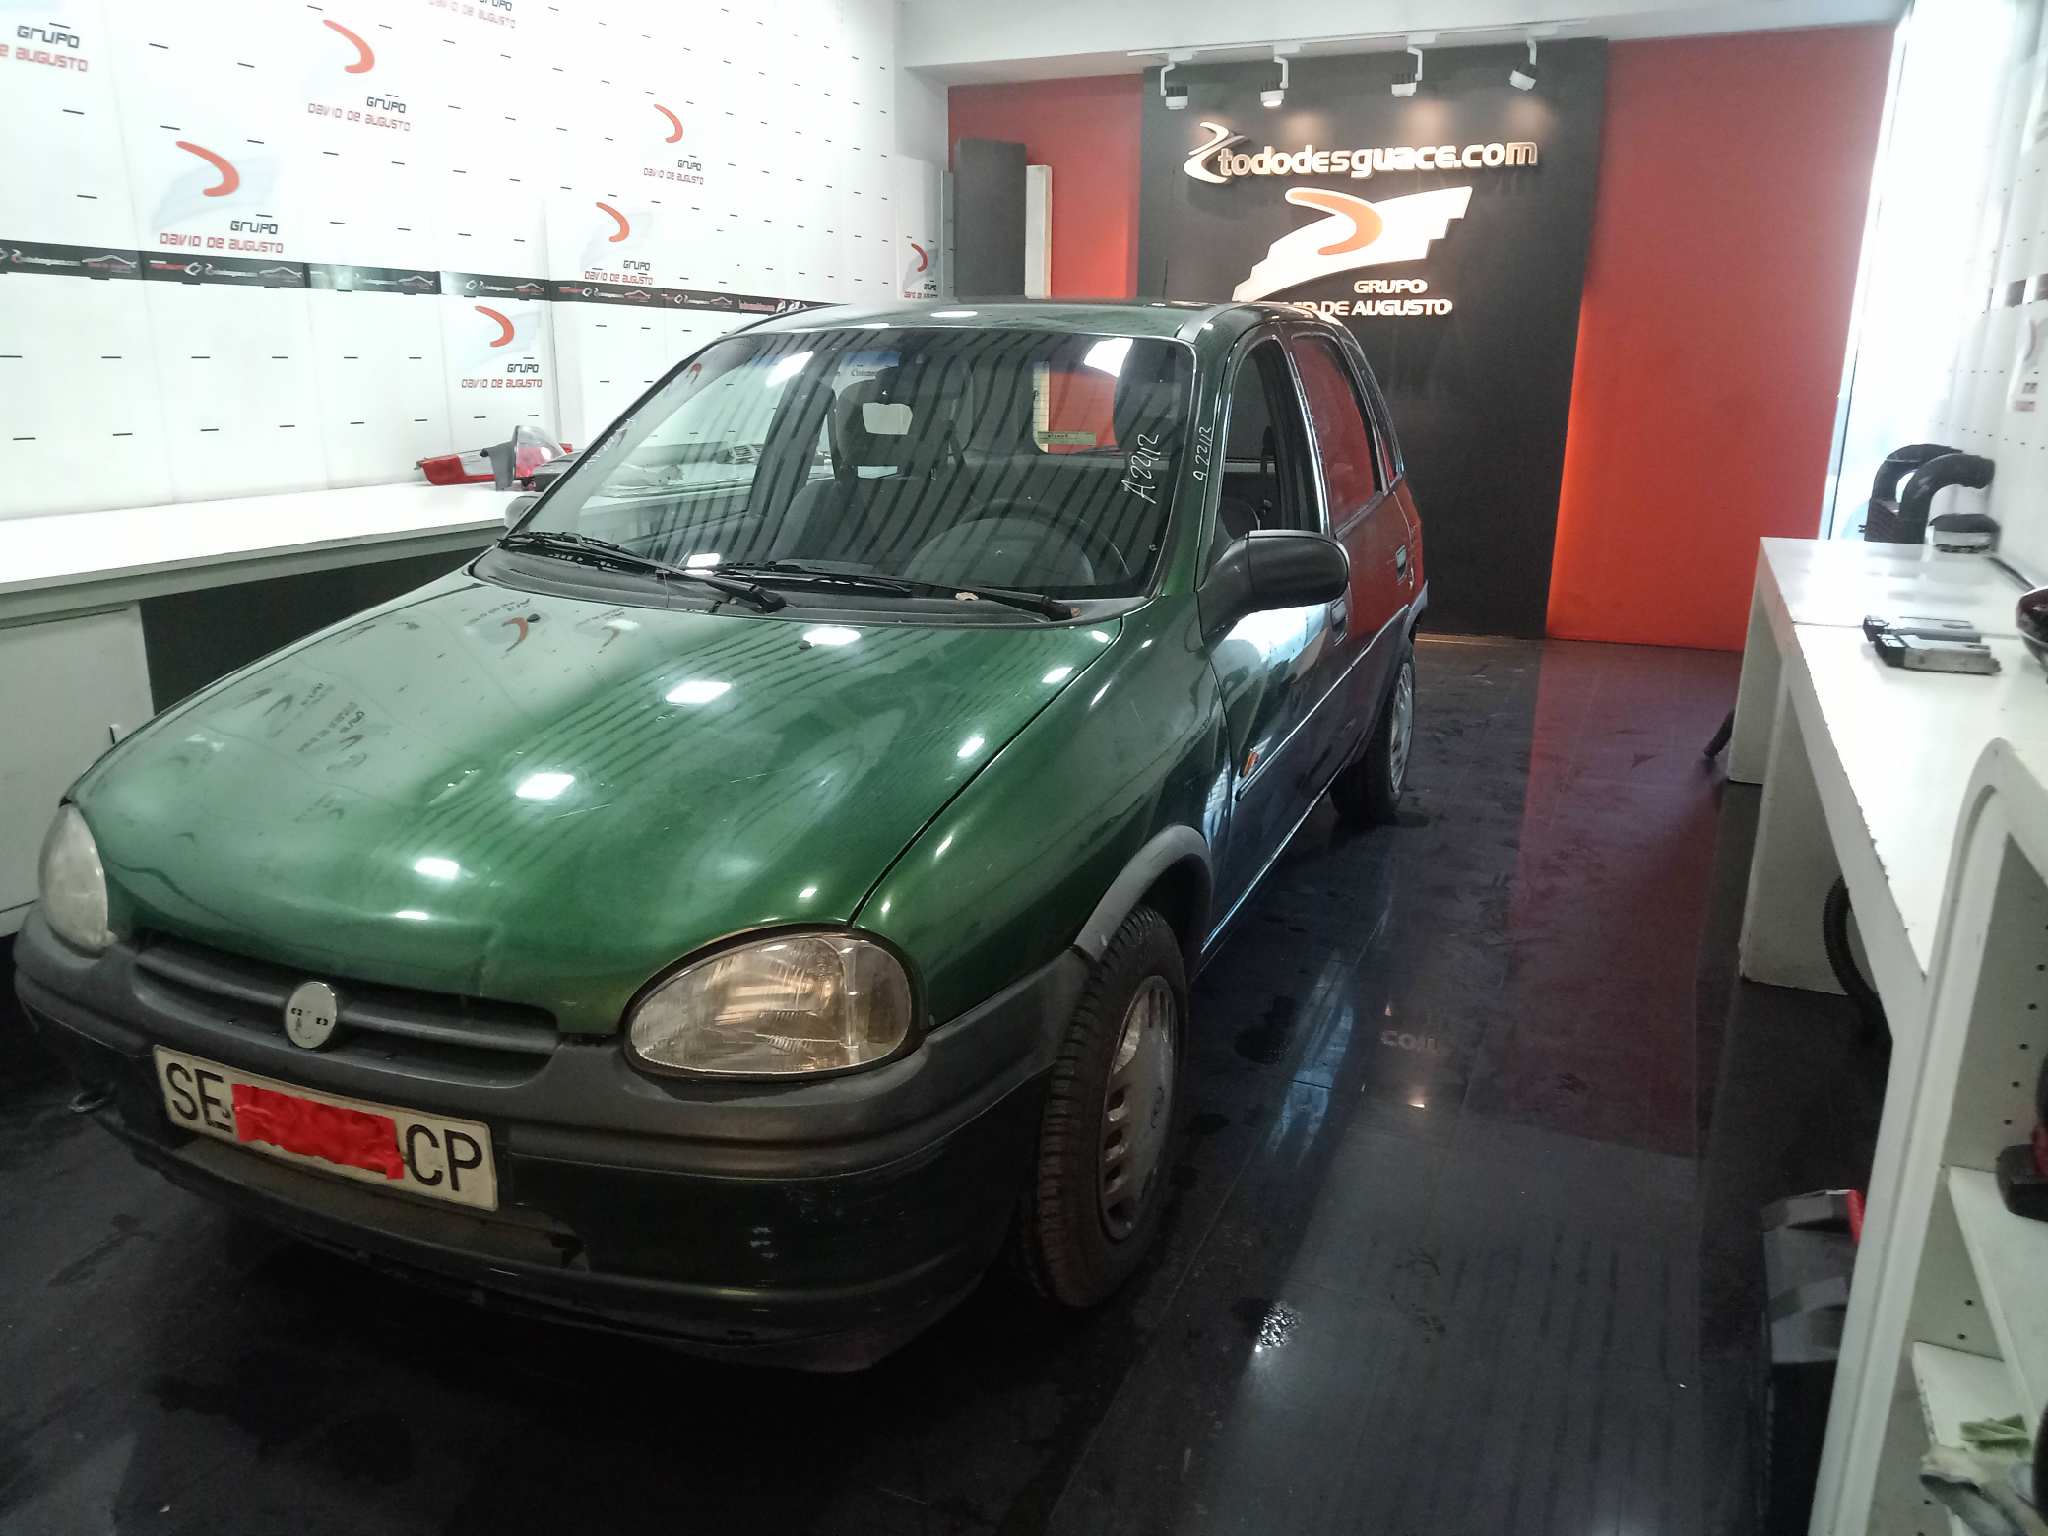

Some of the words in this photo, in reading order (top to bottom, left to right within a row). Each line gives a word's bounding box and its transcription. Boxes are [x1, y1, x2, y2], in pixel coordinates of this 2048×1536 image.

[1217, 141, 1539, 179] tododesguace.com
[230, 220, 279, 235] GRUPO
[1353, 279, 1428, 294] GRUPO
[1320, 301, 1350, 316] DE
[1351, 299, 1453, 316] AUGUSTO
[166, 1062, 234, 1134] SE
[405, 1124, 482, 1192] CP
